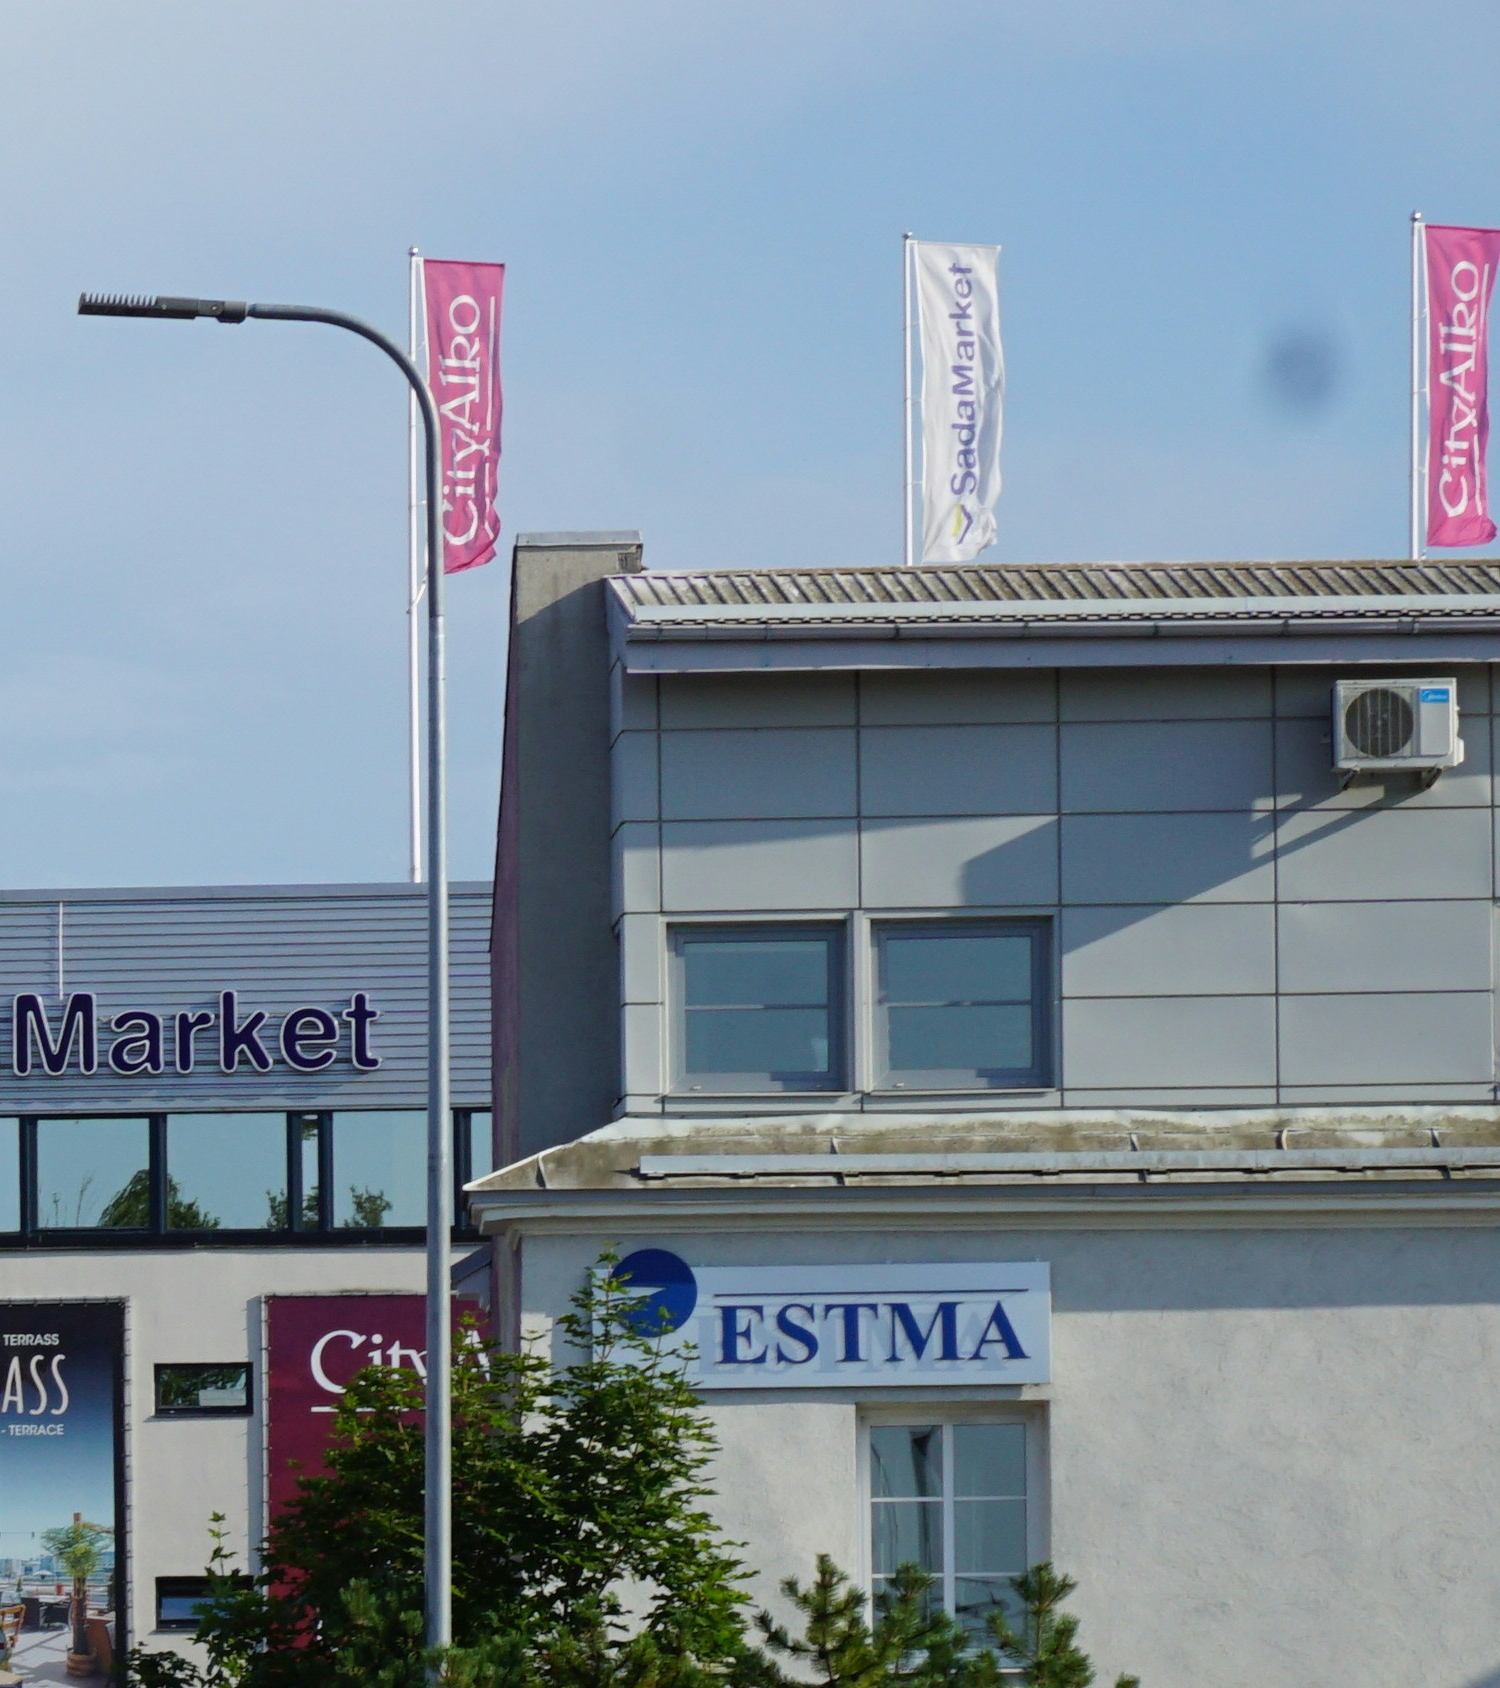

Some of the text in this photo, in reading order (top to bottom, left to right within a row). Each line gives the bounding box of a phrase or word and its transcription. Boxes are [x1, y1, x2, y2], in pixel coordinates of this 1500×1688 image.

[442, 294, 481, 546] CityAlko
[948, 262, 977, 496] SadaMarket
[1438, 260, 1480, 517] CityAlko
[3, 1333, 60, 1347] TERRASS
[713, 1300, 1032, 1365] ESTMA
[8, 1424, 65, 1437] TERRACE
